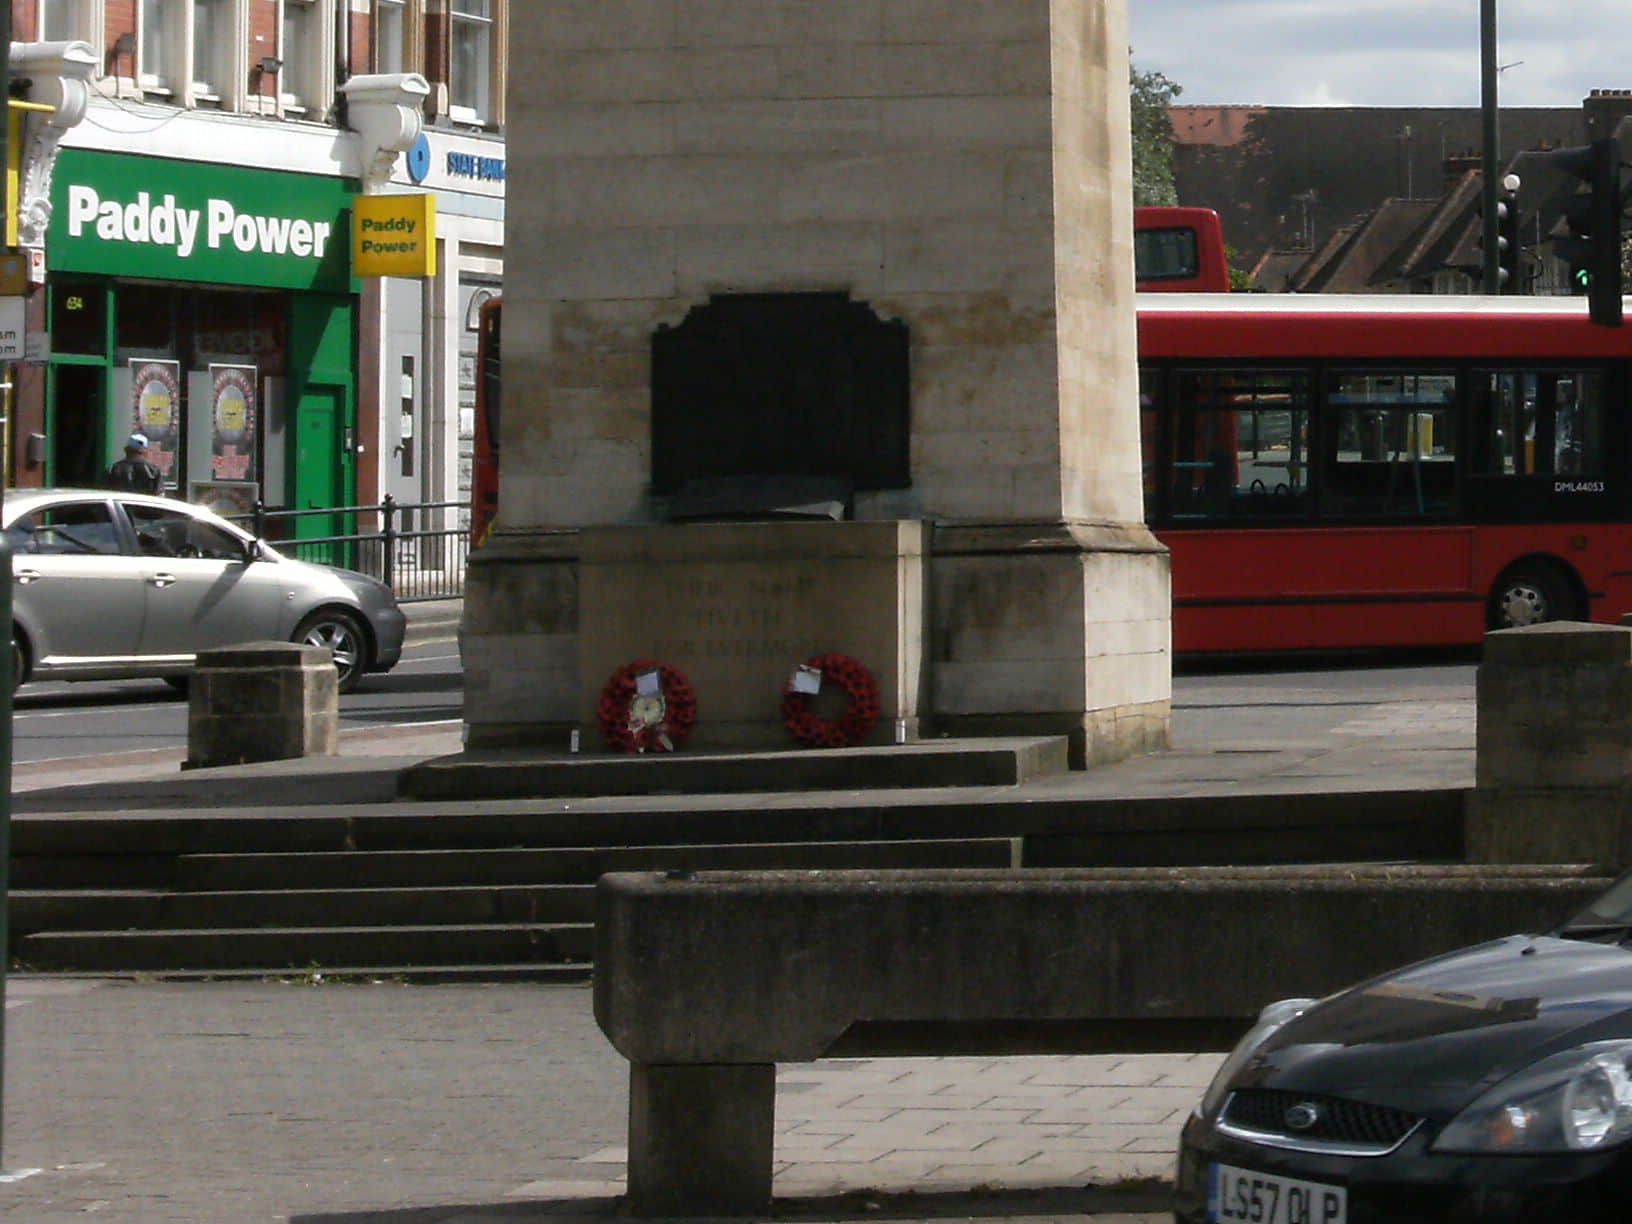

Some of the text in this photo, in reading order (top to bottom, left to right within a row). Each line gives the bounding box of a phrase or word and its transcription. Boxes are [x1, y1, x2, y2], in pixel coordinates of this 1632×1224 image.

[68, 184, 330, 258] Paddy Power
[361, 218, 416, 233] Paddy
[361, 240, 417, 253] Power
[1222, 1173, 1280, 1224] LS57
